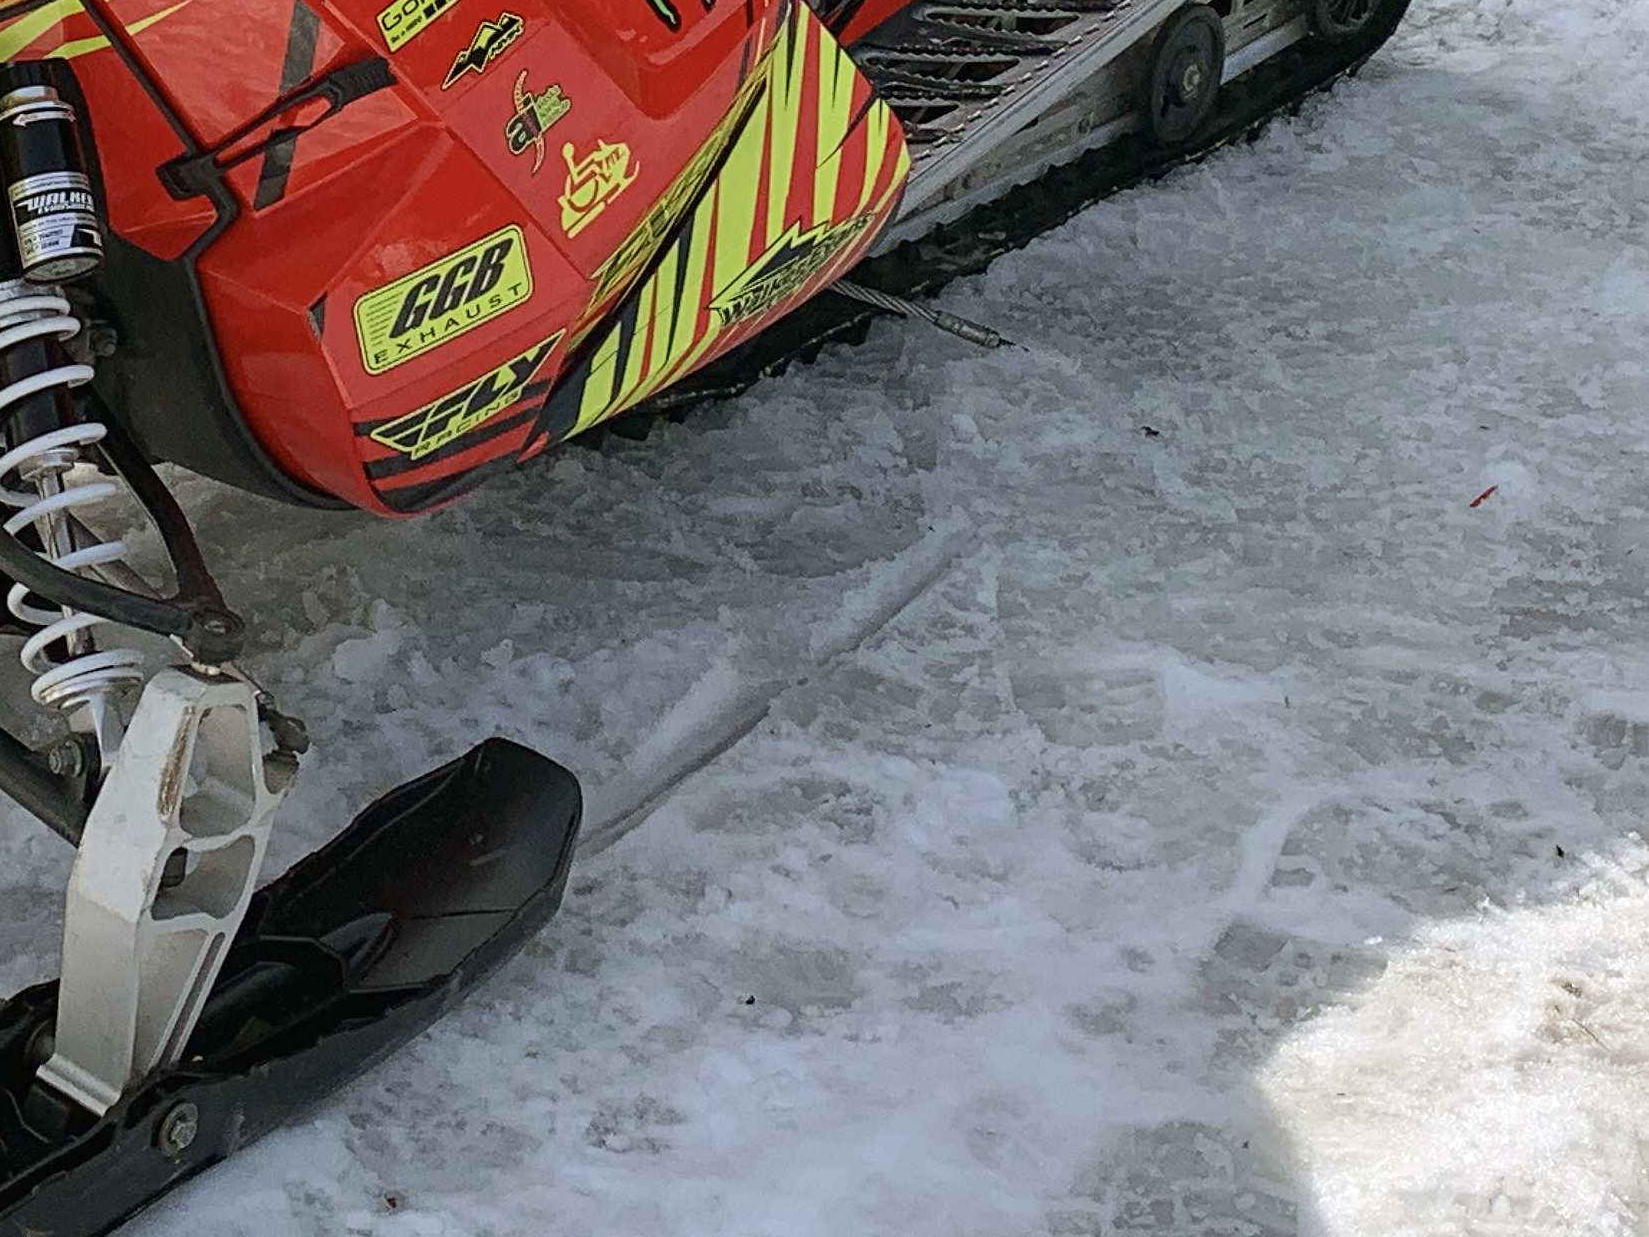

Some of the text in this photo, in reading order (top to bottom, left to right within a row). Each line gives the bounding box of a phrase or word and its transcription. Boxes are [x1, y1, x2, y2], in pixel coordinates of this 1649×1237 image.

[373, 281, 523, 365] EXHAUST
[389, 238, 514, 340] GGB
[374, 332, 563, 452] FLY
[413, 390, 520, 457] RACING
